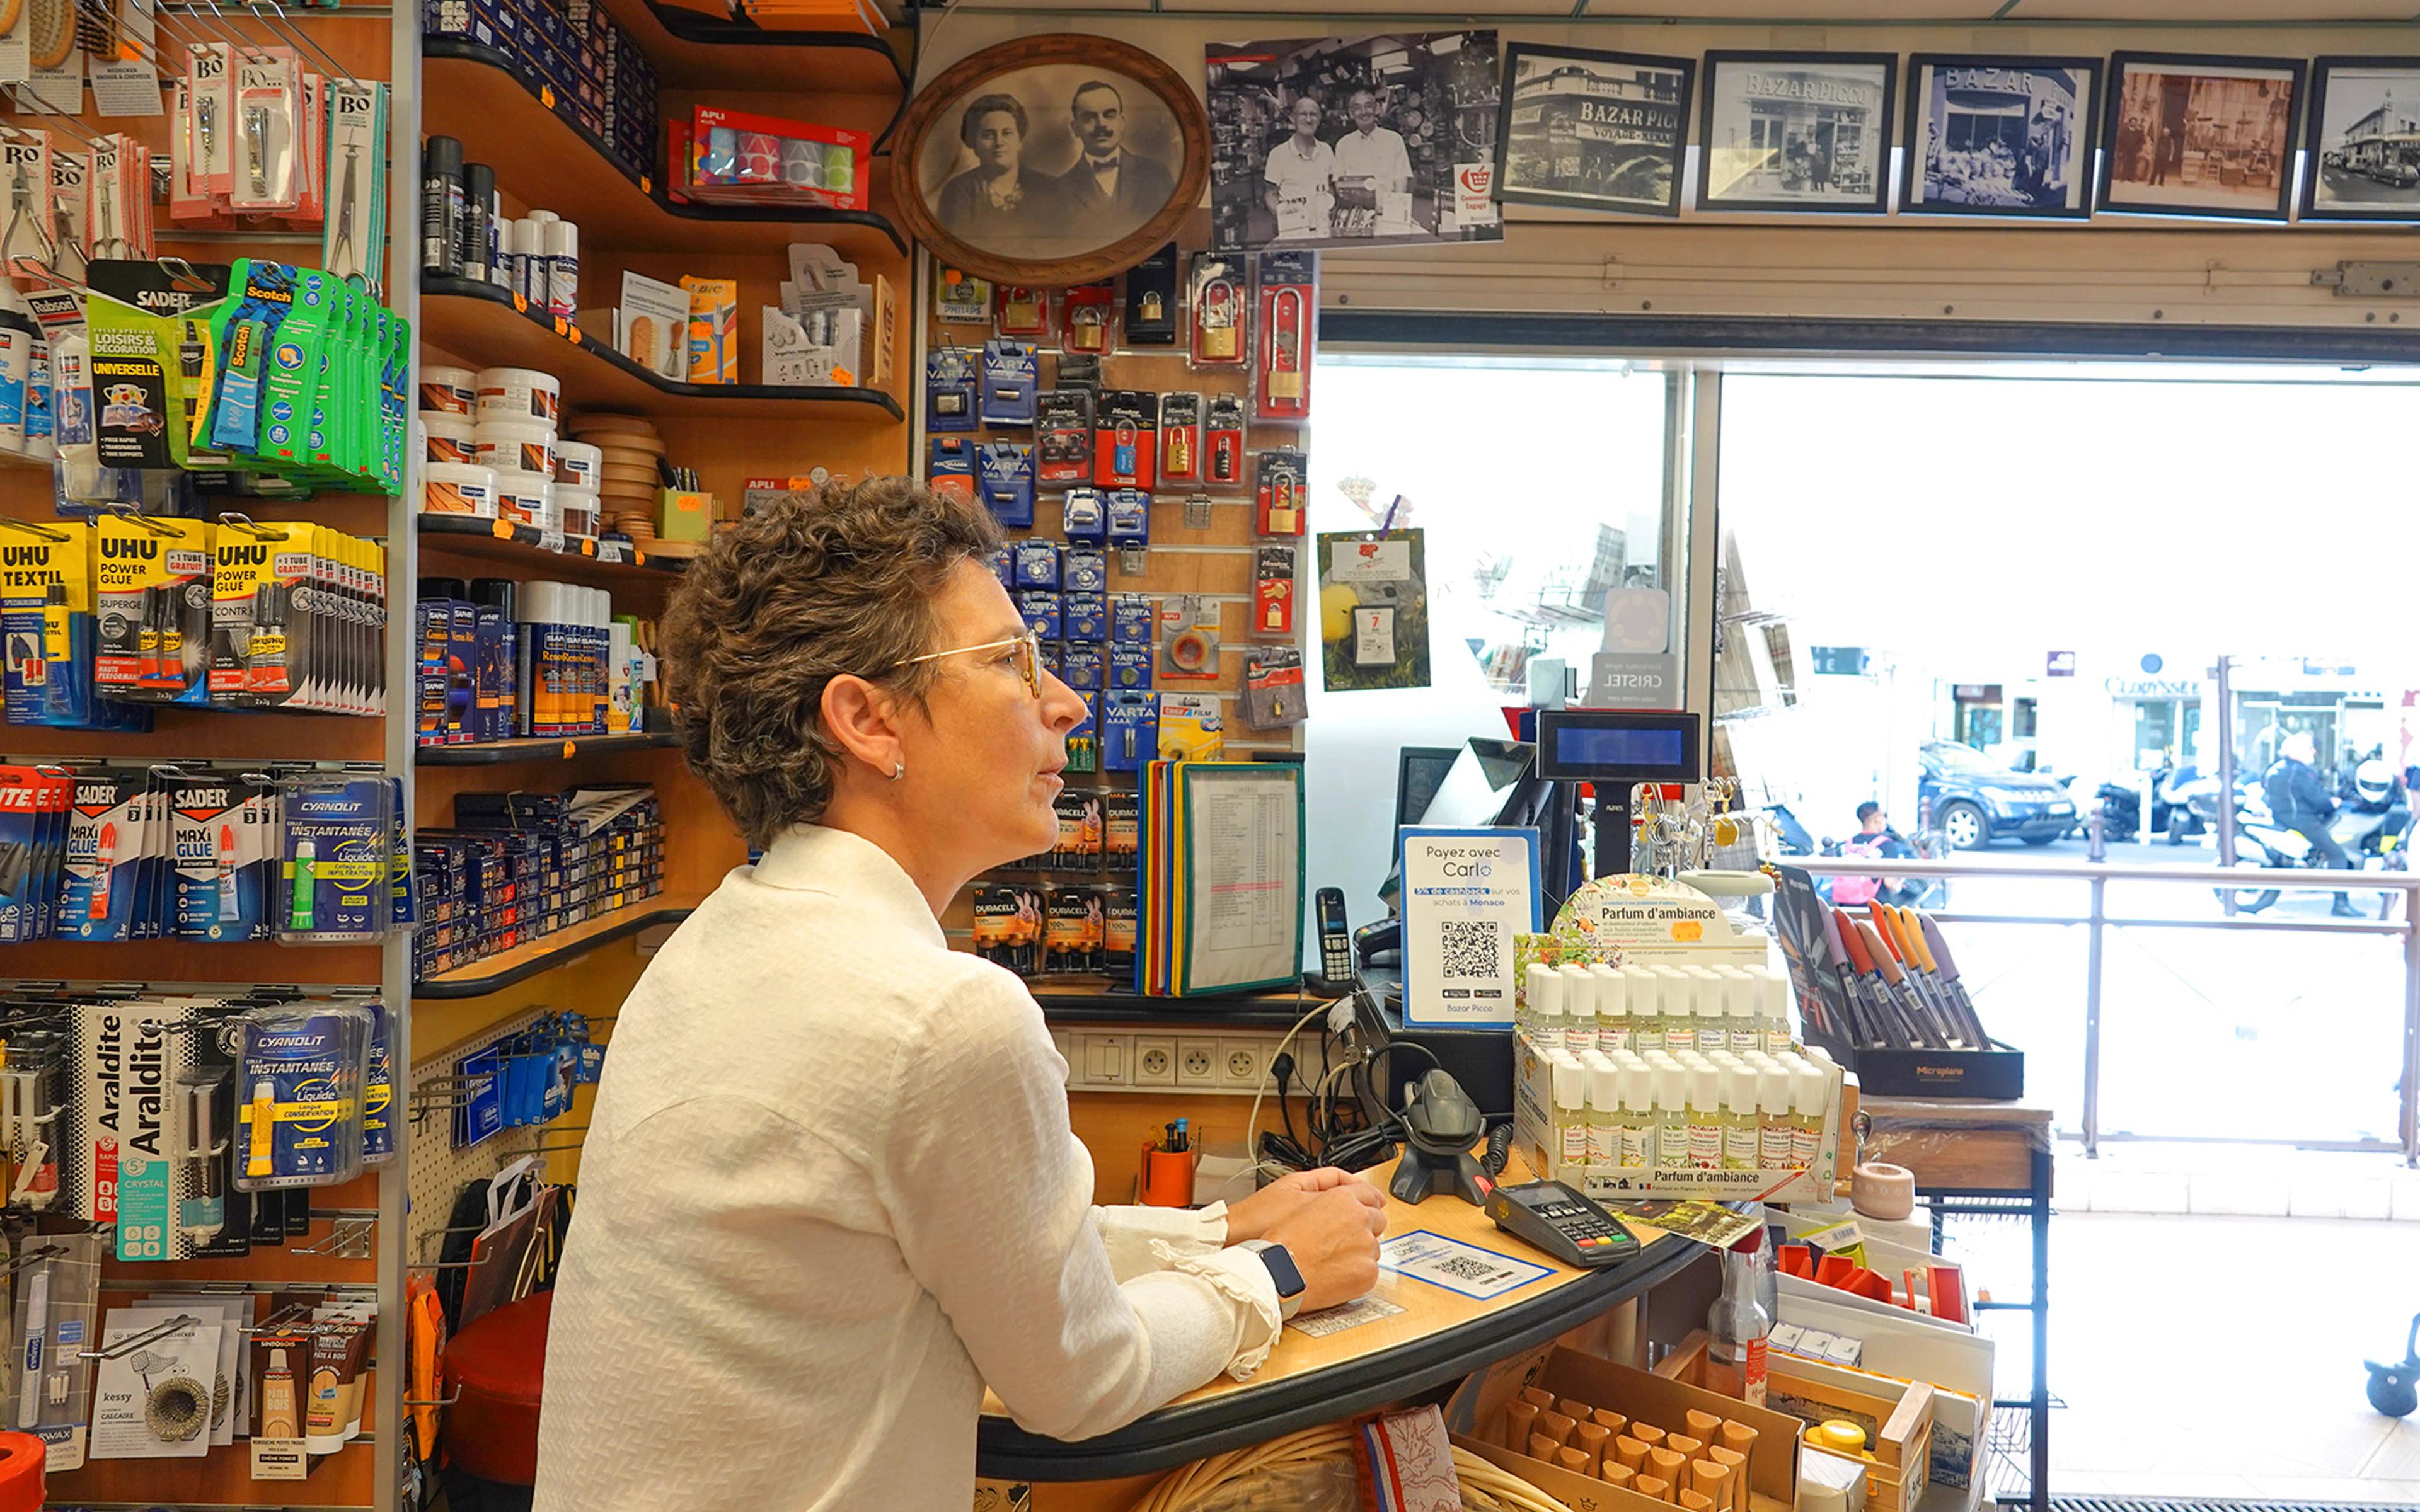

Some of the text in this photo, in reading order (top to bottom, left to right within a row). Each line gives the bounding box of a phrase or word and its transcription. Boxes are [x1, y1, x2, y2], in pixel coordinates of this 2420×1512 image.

[197, 60, 222, 78] BO
[1945, 67, 2032, 94] BAZAR
[1745, 73, 1868, 105] BAZAR PICCO
[340, 96, 370, 113] BO
[701, 110, 725, 120] APLI
[1580, 101, 1643, 126] BAZAR
[137, 291, 191, 308] SADER
[247, 287, 292, 302] Scotch
[33, 296, 74, 313] Rubson
[944, 304, 982, 314] PHILIPS
[95, 333, 157, 346] LOISIRS &
[231, 326, 251, 368] Scotch
[93, 363, 159, 376] UNIVERSELLE
[986, 358, 1035, 372] VARTA
[927, 369, 975, 379] VARTA
[278, 449, 293, 458] 3M
[316, 452, 330, 461] 3M
[982, 461, 1032, 472] VARTA
[749, 481, 775, 489] APLI
[101, 538, 158, 560] UHU
[3, 546, 49, 566] UHU
[183, 553, 202, 562] TUBE
[218, 545, 267, 566] UHU
[291, 556, 308, 565] TUBE
[101, 563, 147, 575] POWER
[170, 561, 202, 570] GRATUIT
[278, 565, 308, 574] GRATUIT
[4, 571, 64, 586] TEXTIL
[100, 574, 132, 585] GLUE
[216, 570, 256, 580] POWER
[216, 582, 243, 592] GLUE
[100, 599, 142, 609] SUPERGE
[1023, 602, 1058, 611] VARTA
[1069, 604, 1103, 613] VARTA
[1117, 608, 1151, 617] VARTA
[1113, 653, 1147, 662] VARTA
[1107, 706, 1156, 718] VARTA
[75, 786, 116, 805] SADER
[175, 788, 228, 808] SADER
[301, 802, 362, 812] CYANOLIT
[1109, 808, 1138, 816] DURAC
[247, 813, 253, 823] 3
[291, 823, 372, 837] INSTANTANÉE
[69, 840, 97, 853] GLUE
[176, 843, 212, 857] GLUE
[338, 852, 375, 863] Liquide
[1427, 846, 1501, 860] Payez avec
[1443, 861, 1492, 877] Carlo
[975, 905, 1015, 913] DURACELL
[1602, 907, 1716, 920] Parfum d'ambiance
[1447, 1004, 1493, 1012] Bazar Picco
[258, 1035, 325, 1048] CYANOLIT
[97, 1014, 121, 1131] Araldite
[250, 1058, 336, 1075] INSTANTANÉE
[1916, 1066, 1964, 1077] Microplane
[129, 1018, 163, 1156] Araldite
[296, 1089, 336, 1102] Liquide
[284, 1109, 336, 1118] CONSERVATION
[129, 1161, 139, 1172] 5
[1654, 1171, 1760, 1183] Parfum d'ambiance
[125, 1179, 166, 1188] CRYSTAL
[103, 1392, 132, 1403] kessy
[267, 1399, 290, 1411] BOIS
[101, 1412, 134, 1420] CALCAIRE
[38, 1429, 71, 1442] RWAX
